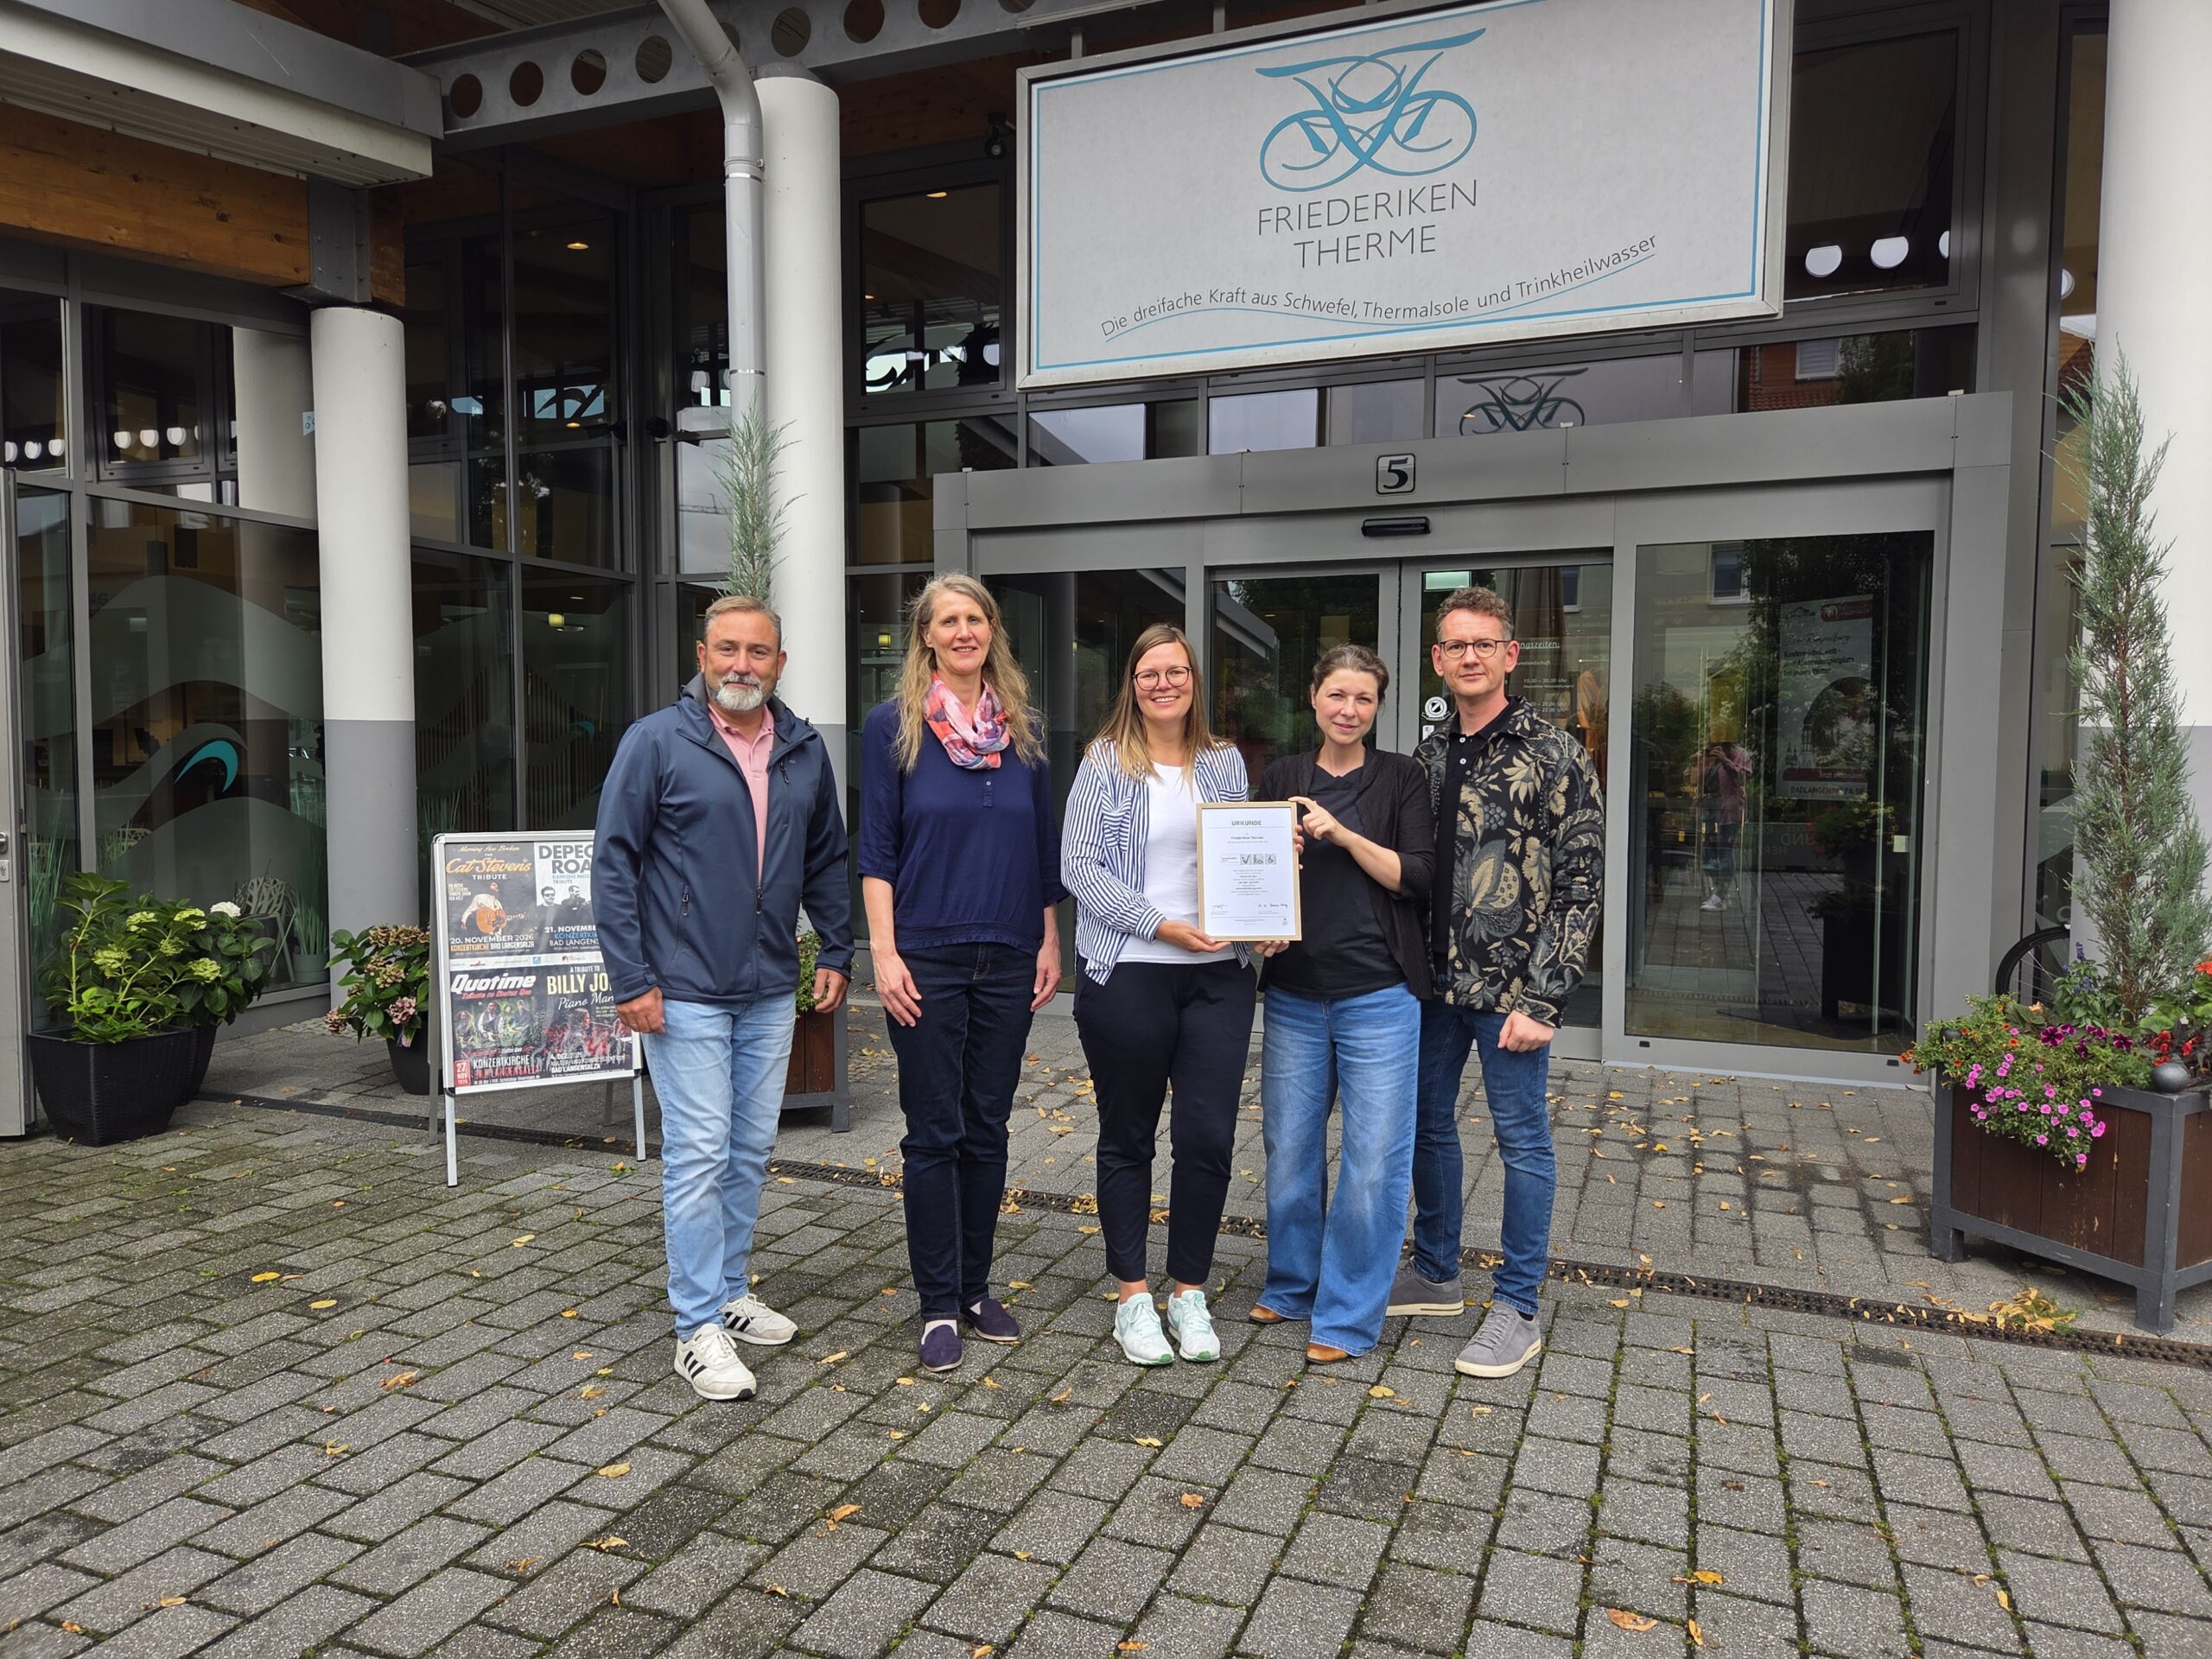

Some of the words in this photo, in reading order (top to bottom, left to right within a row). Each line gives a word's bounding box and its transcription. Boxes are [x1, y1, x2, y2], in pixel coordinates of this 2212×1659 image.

[1258, 179, 1478, 236] FRIEDERIKEN
[1293, 224, 1436, 269] THERME
[1100, 314, 1128, 336] Die
[1133, 291, 1204, 322] dreifache
[1209, 287, 1247, 304] Kraft
[1250, 291, 1279, 307] aus
[1283, 292, 1358, 319] Schwefel,
[1363, 296, 1470, 321] Thermalsole
[1477, 284, 1512, 309] und
[1515, 233, 1657, 299] Trinkheilwasser
[1382, 456, 1409, 490] 5
[538, 844, 594, 860] DEPEC
[445, 857, 474, 874] Cat
[474, 856, 532, 874] Stevens
[551, 858, 591, 874] ROA
[464, 935, 513, 944] NOVEMBER
[501, 940, 535, 949] LANGENSALZA
[449, 972, 537, 995] Quotime
[546, 973, 587, 995] BILLY
[557, 996, 588, 1010] Piano
[590, 991, 614, 1006] Man
[473, 1054, 531, 1070] KONZERTKIRCHE
[563, 1063, 601, 1073] LANGENSALZA
